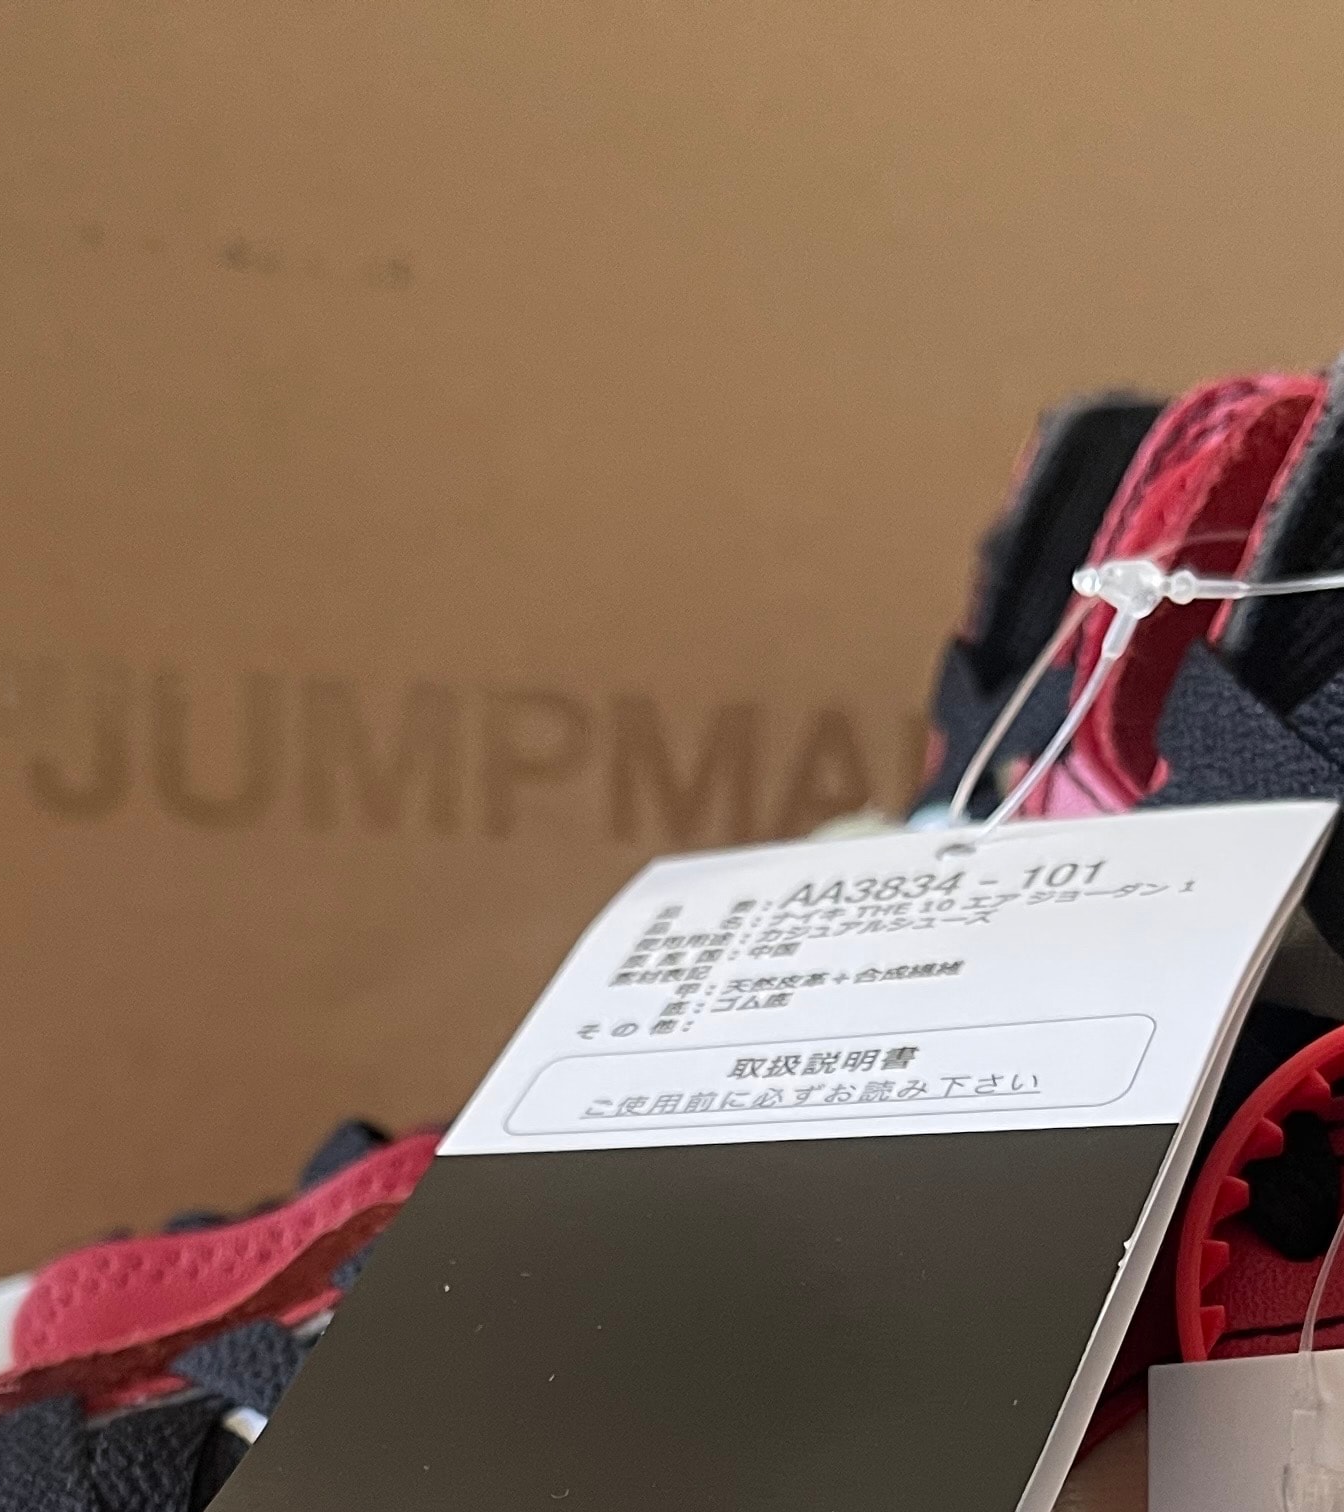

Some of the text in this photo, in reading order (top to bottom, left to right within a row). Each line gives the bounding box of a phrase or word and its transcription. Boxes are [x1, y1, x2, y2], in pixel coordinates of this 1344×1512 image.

[779, 871, 965, 909] AA3834
[1023, 861, 1105, 890] 101
[856, 900, 913, 919] THE
[919, 900, 955, 913] 10
[726, 1046, 919, 1080] 取扱説明書
